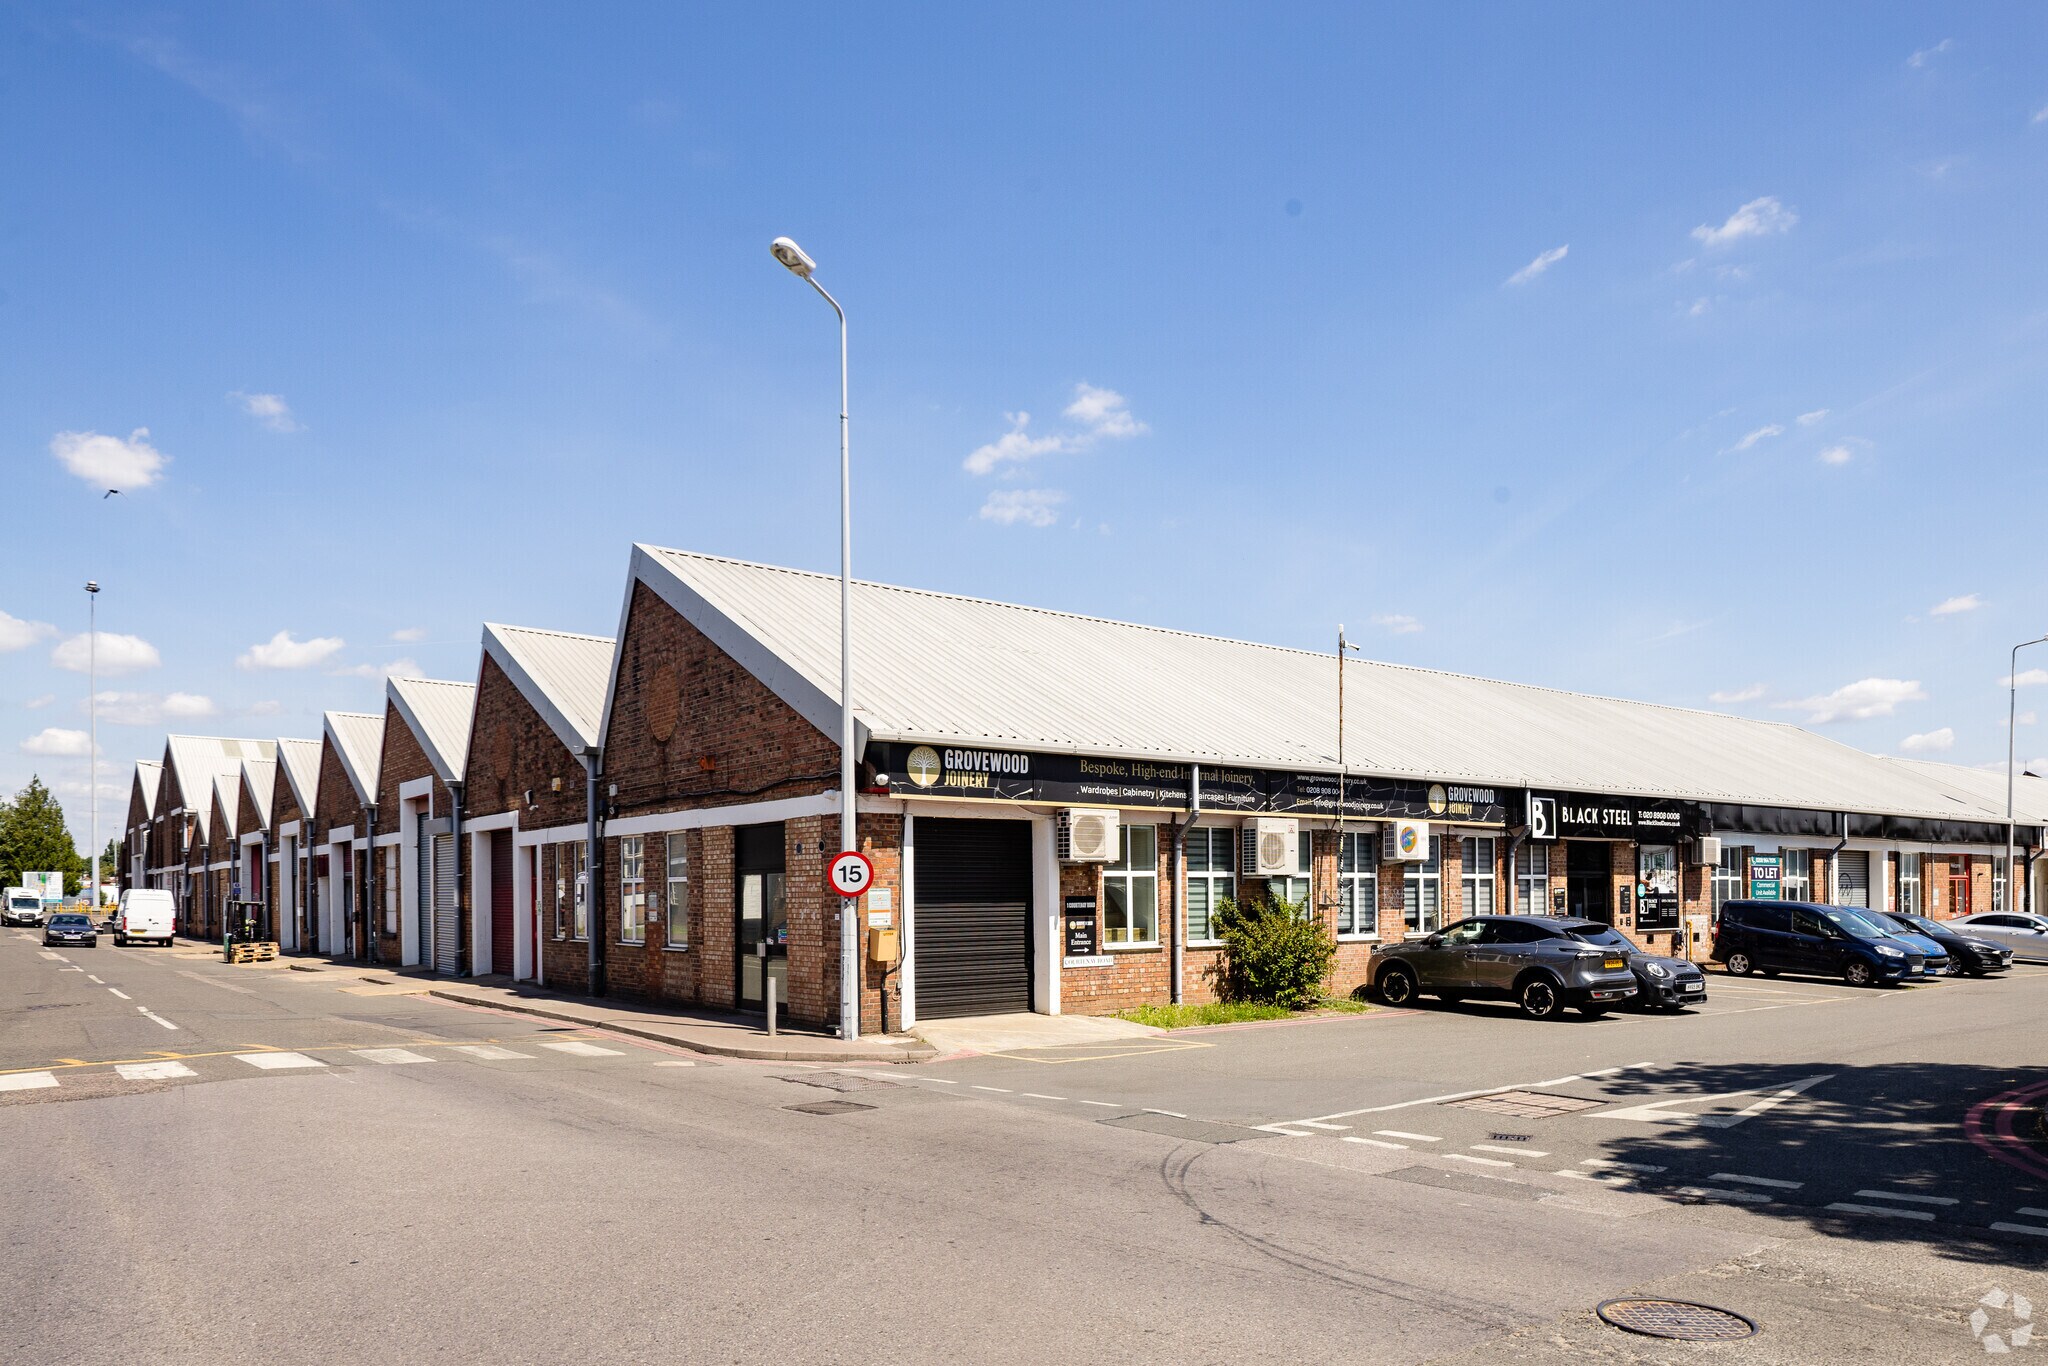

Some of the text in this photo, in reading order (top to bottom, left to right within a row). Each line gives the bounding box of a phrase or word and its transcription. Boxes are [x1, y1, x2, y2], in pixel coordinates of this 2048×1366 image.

[944, 749, 1029, 774] GROVEWOOD
[944, 769, 989, 788] JOINERY
[1080, 759, 1256, 784] Bespoke, High-end Inrnal Joinery.
[1080, 785, 1256, 803] Wardrobes Cabinetry Kitchens aircases Furniture
[1306, 786, 1320, 794] 0208
[1321, 787, 1332, 795] 908
[1448, 786, 1495, 804] GROVEWOOD
[1448, 802, 1473, 815] JOINERY
[1562, 806, 1633, 826] BLACK STEEL
[1532, 799, 1548, 837] B
[838, 865, 862, 883] 15
[1753, 867, 1778, 879] TO LET
